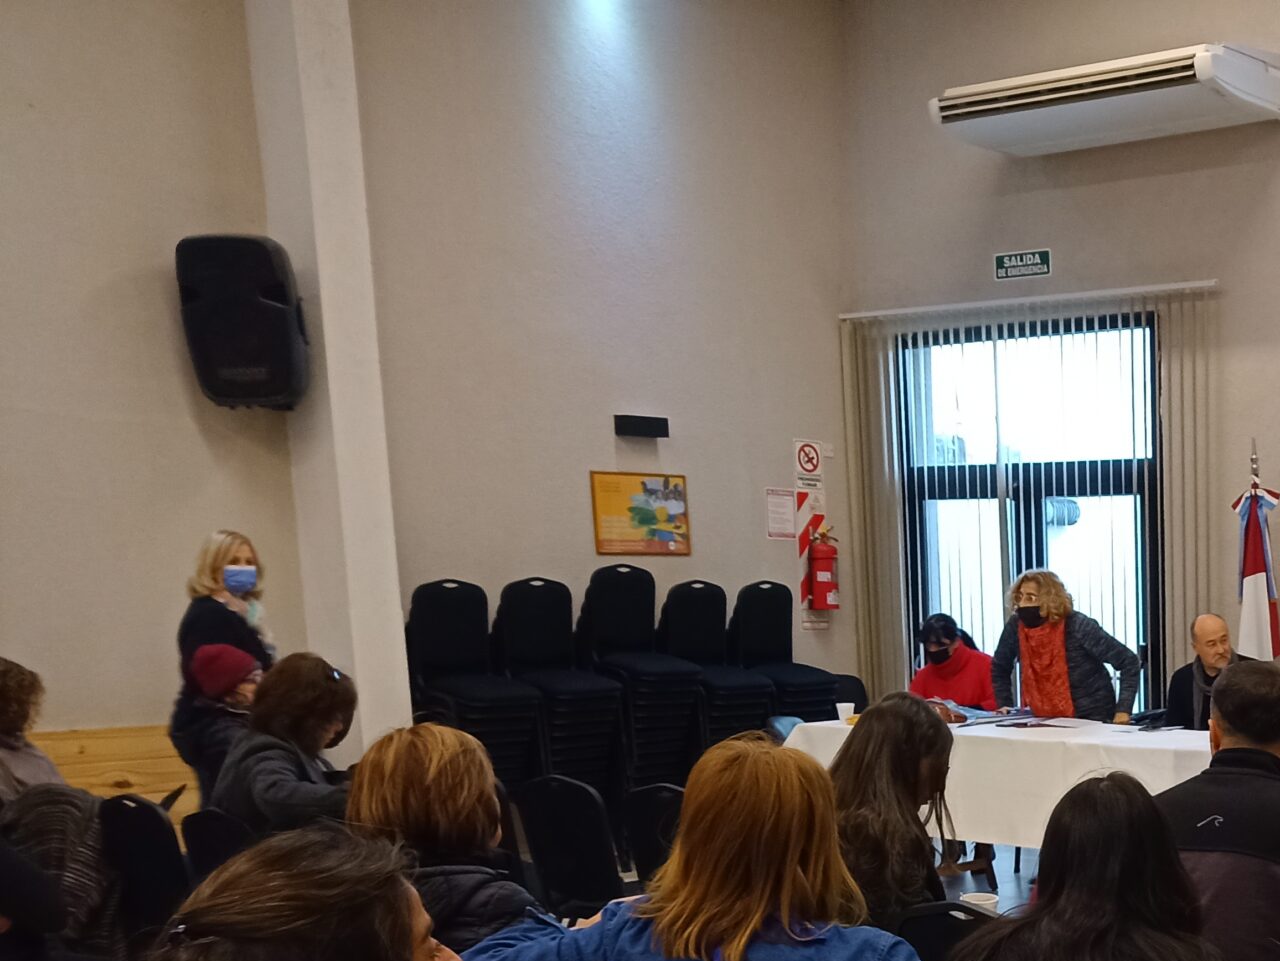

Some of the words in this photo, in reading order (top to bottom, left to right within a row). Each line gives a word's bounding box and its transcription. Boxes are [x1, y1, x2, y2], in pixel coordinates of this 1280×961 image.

[1003, 254, 1041, 267] SALIDA
[998, 268, 1006, 278] DE
[1007, 264, 1048, 276] EMERGENCIA
